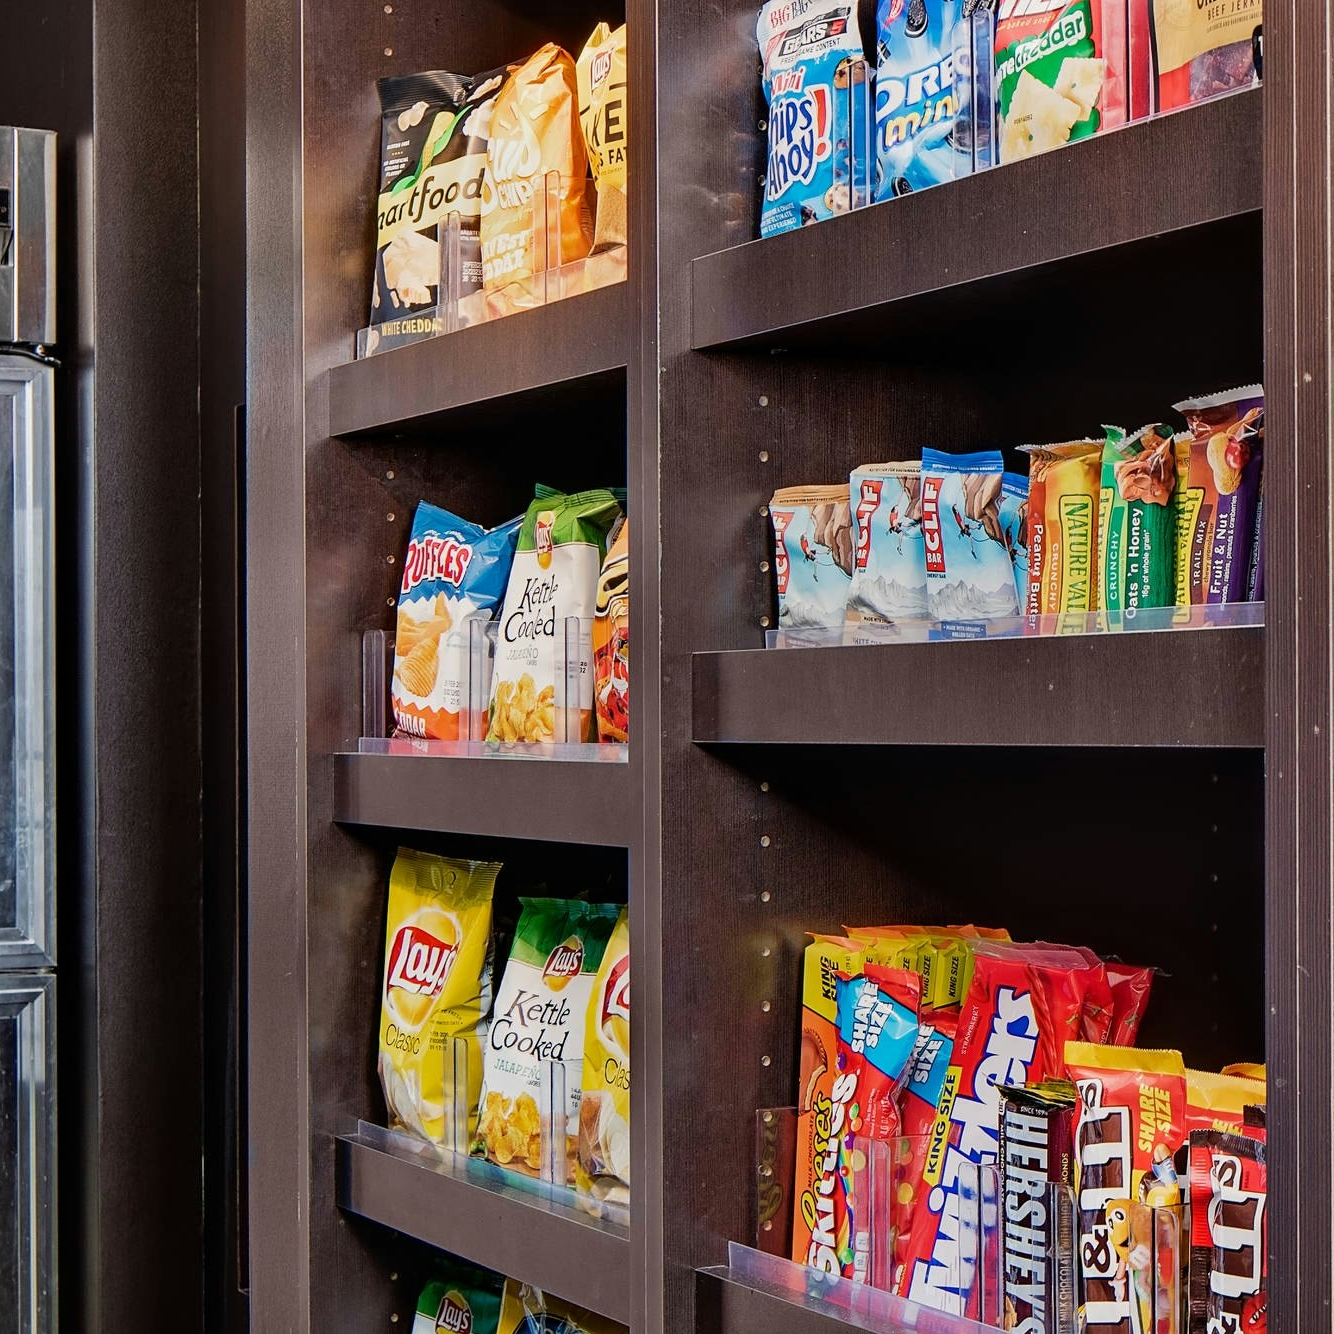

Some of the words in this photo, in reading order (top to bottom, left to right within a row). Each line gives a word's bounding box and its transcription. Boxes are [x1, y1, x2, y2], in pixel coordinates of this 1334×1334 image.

[770, 4, 790, 28] BIG
[1207, 5, 1226, 19] BEEF
[769, 99, 813, 145] hips
[381, 321, 400, 336] WHITE
[858, 484, 881, 548] CLIF
[924, 481, 940, 551] CLIF
[1129, 508, 1144, 559] Honey
[1196, 520, 1207, 545] MIX
[1215, 512, 1229, 542] Nut
[927, 553, 942, 565] BAR
[1032, 524, 1044, 578] Peanut
[1063, 502, 1088, 577] NATURE
[1204, 538, 1213, 564] granola
[1215, 544, 1225, 558] &
[402, 537, 473, 592] RUFFLES
[1049, 543, 1059, 611] CRUNCHY
[1110, 530, 1119, 601] CRUNCHY
[1142, 576, 1148, 585] of
[1192, 549, 1202, 587] TRAIL
[1202, 564, 1210, 584] chewy
[1210, 559, 1223, 594] Fruit
[517, 573, 559, 613] Kettle
[1028, 582, 1041, 630] Butter
[1125, 582, 1139, 619] Oats
[389, 930, 459, 1000] Lay's
[547, 945, 584, 978] Lay's
[924, 954, 932, 976] SIZE
[951, 954, 960, 977] SIZE
[948, 976, 957, 998] KING
[504, 989, 571, 1028] Kettle
[851, 980, 879, 1054] SHARE
[865, 1000, 893, 1049] SIZE
[385, 1022, 421, 1056] Classic
[490, 1018, 570, 1062] Cooked
[960, 1004, 980, 1056] STRAWBERRY
[913, 1038, 945, 1084] SIZE
[926, 1122, 946, 1175] KING
[938, 1073, 957, 1118] SIZE
[1138, 1083, 1156, 1154] SHARE
[1154, 1086, 1171, 1139] SIZE
[807, 1113, 816, 1170] CHOCOLATE
